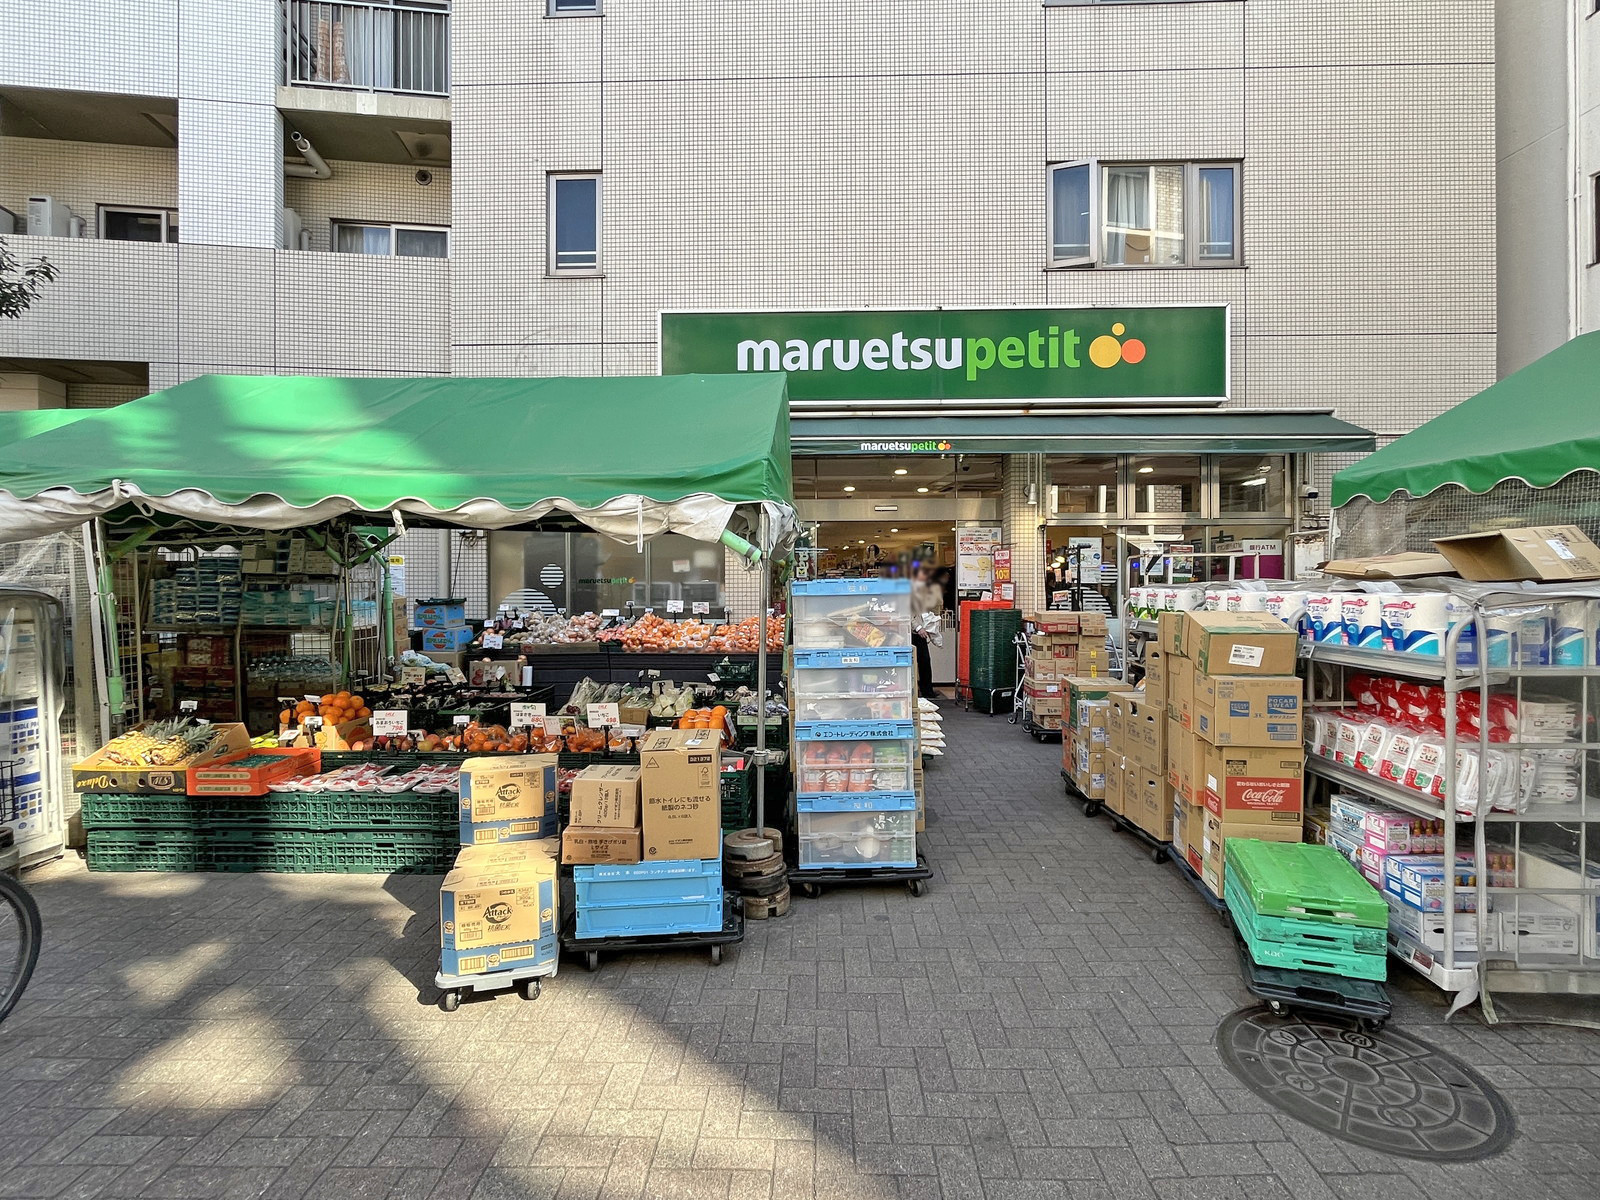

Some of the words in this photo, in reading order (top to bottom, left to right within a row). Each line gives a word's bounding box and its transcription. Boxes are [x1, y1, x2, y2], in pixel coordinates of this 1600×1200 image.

[737, 326, 1081, 381] maruetsupetit
[861, 441, 937, 453] maruetsupetit
[1306, 605, 1329, 613] エリエール
[1341, 606, 1365, 615] エリエール
[1381, 610, 1412, 619] エリエール
[75, 775, 109, 788] Deluxe
[495, 786, 521, 797] Attack
[482, 906, 513, 919] Attack
